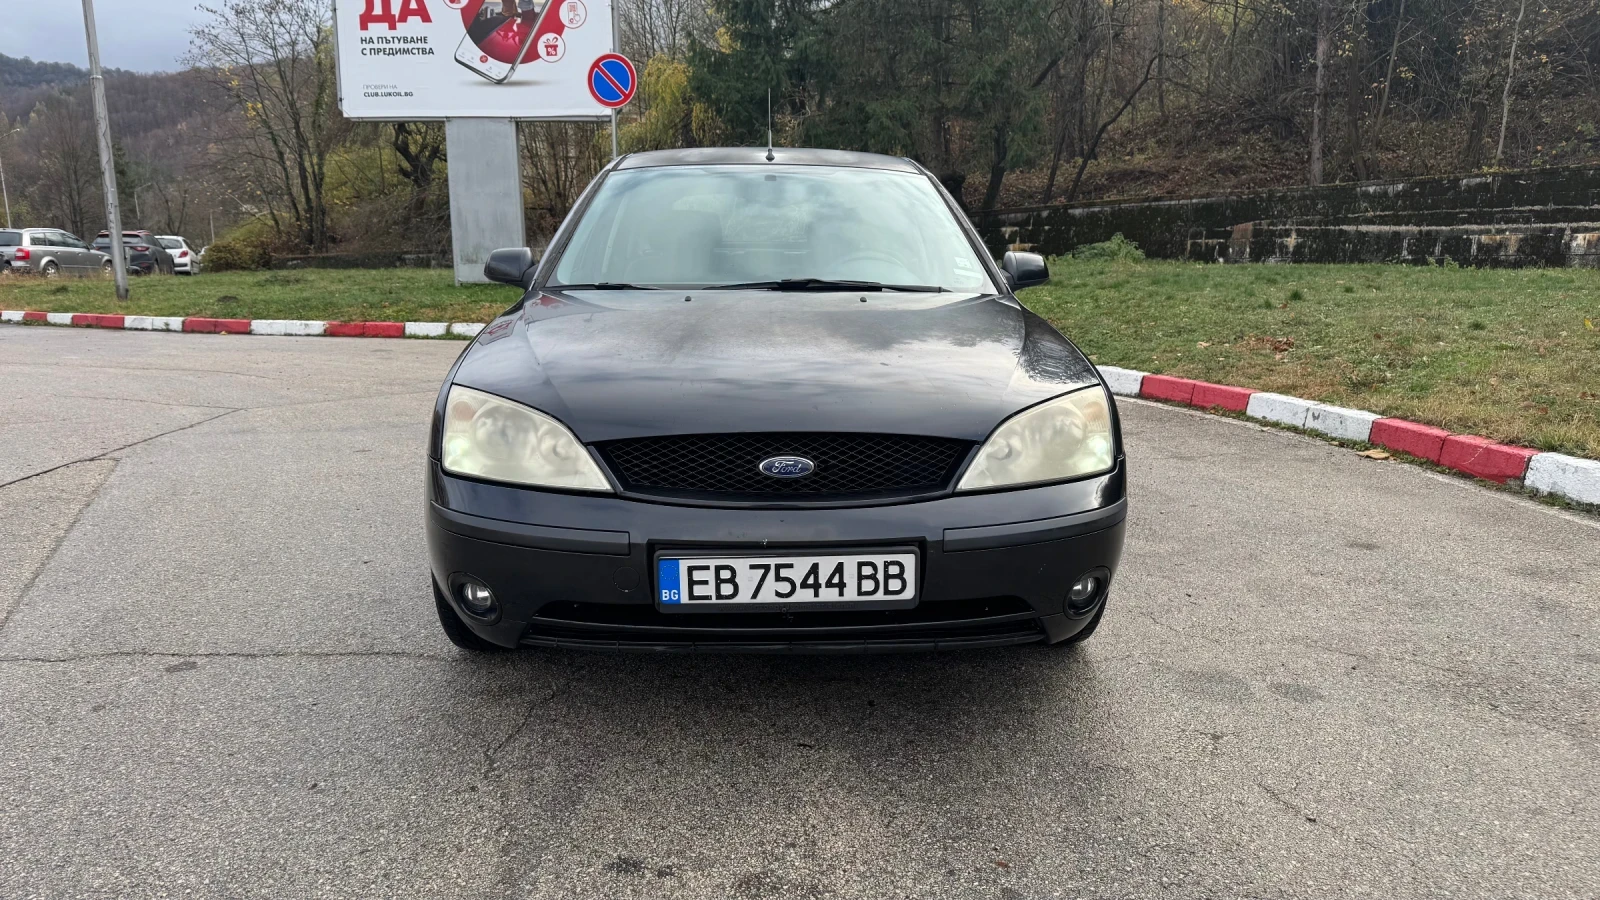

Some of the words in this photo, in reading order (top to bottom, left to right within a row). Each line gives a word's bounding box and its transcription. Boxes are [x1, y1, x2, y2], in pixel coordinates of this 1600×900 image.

[359, 0, 433, 31] ДА
[360, 36, 375, 45] НА
[377, 36, 428, 45] ПЪТУВАНЕ
[361, 47, 367, 56] С
[369, 47, 435, 57] ПРЕДИМСТВА
[771, 460, 802, 473] Ford
[686, 564, 740, 601] EB
[748, 561, 847, 600] 7544
[856, 560, 908, 597] BB
[662, 589, 679, 601] BG
